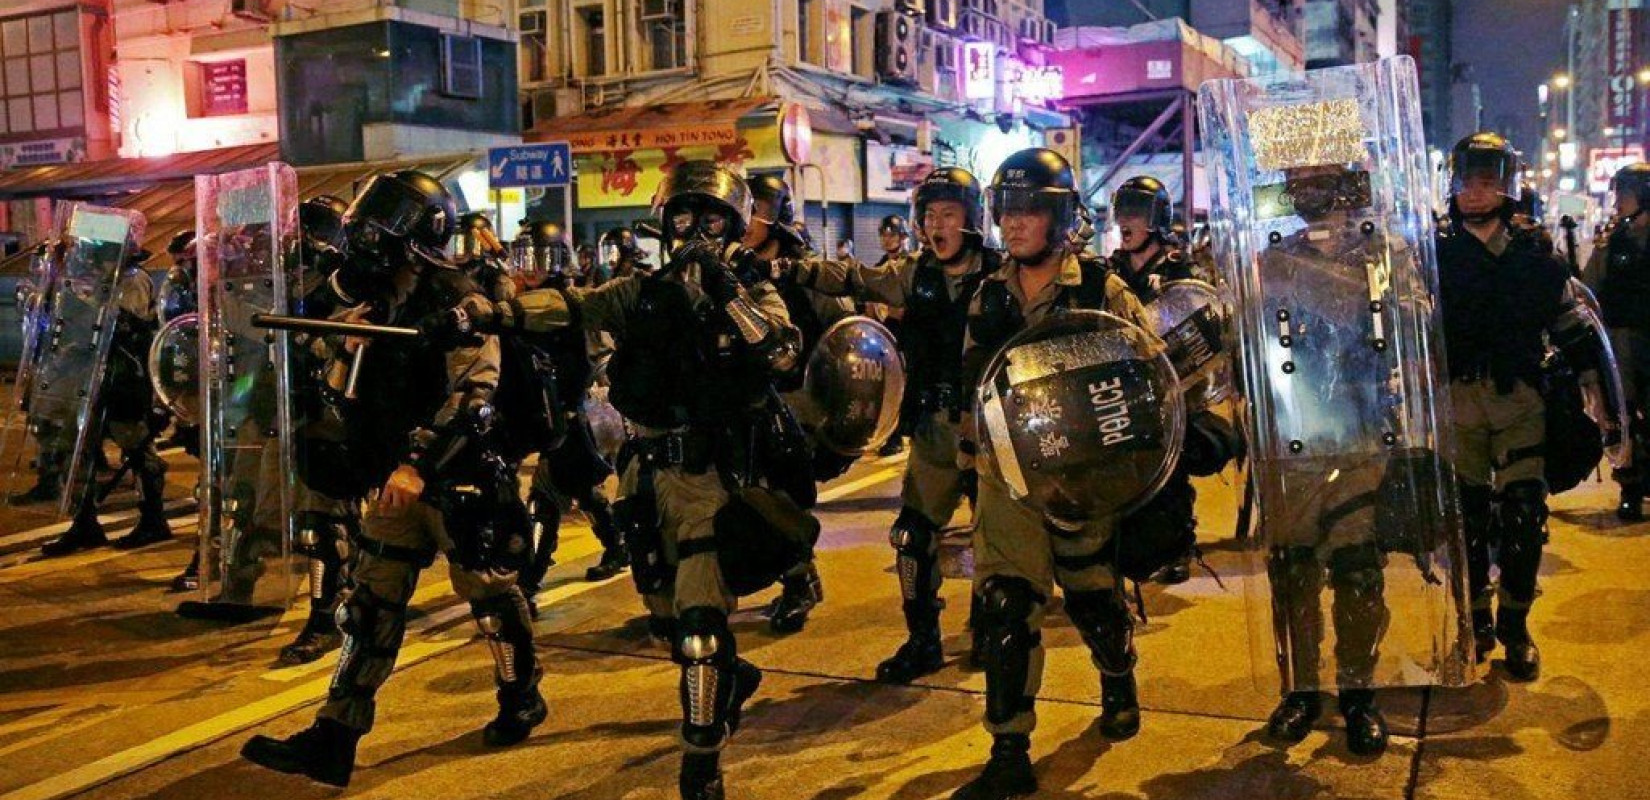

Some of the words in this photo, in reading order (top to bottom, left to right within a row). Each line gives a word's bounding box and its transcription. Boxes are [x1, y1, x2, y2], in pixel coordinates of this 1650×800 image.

[571, 138, 595, 148] ONG
[655, 133, 675, 143] HOI
[680, 130, 699, 141] TIN
[702, 128, 734, 141] TONG
[510, 149, 549, 161] Subway
[1088, 376, 1135, 446] POLICE
[1025, 396, 1071, 458] 警察
